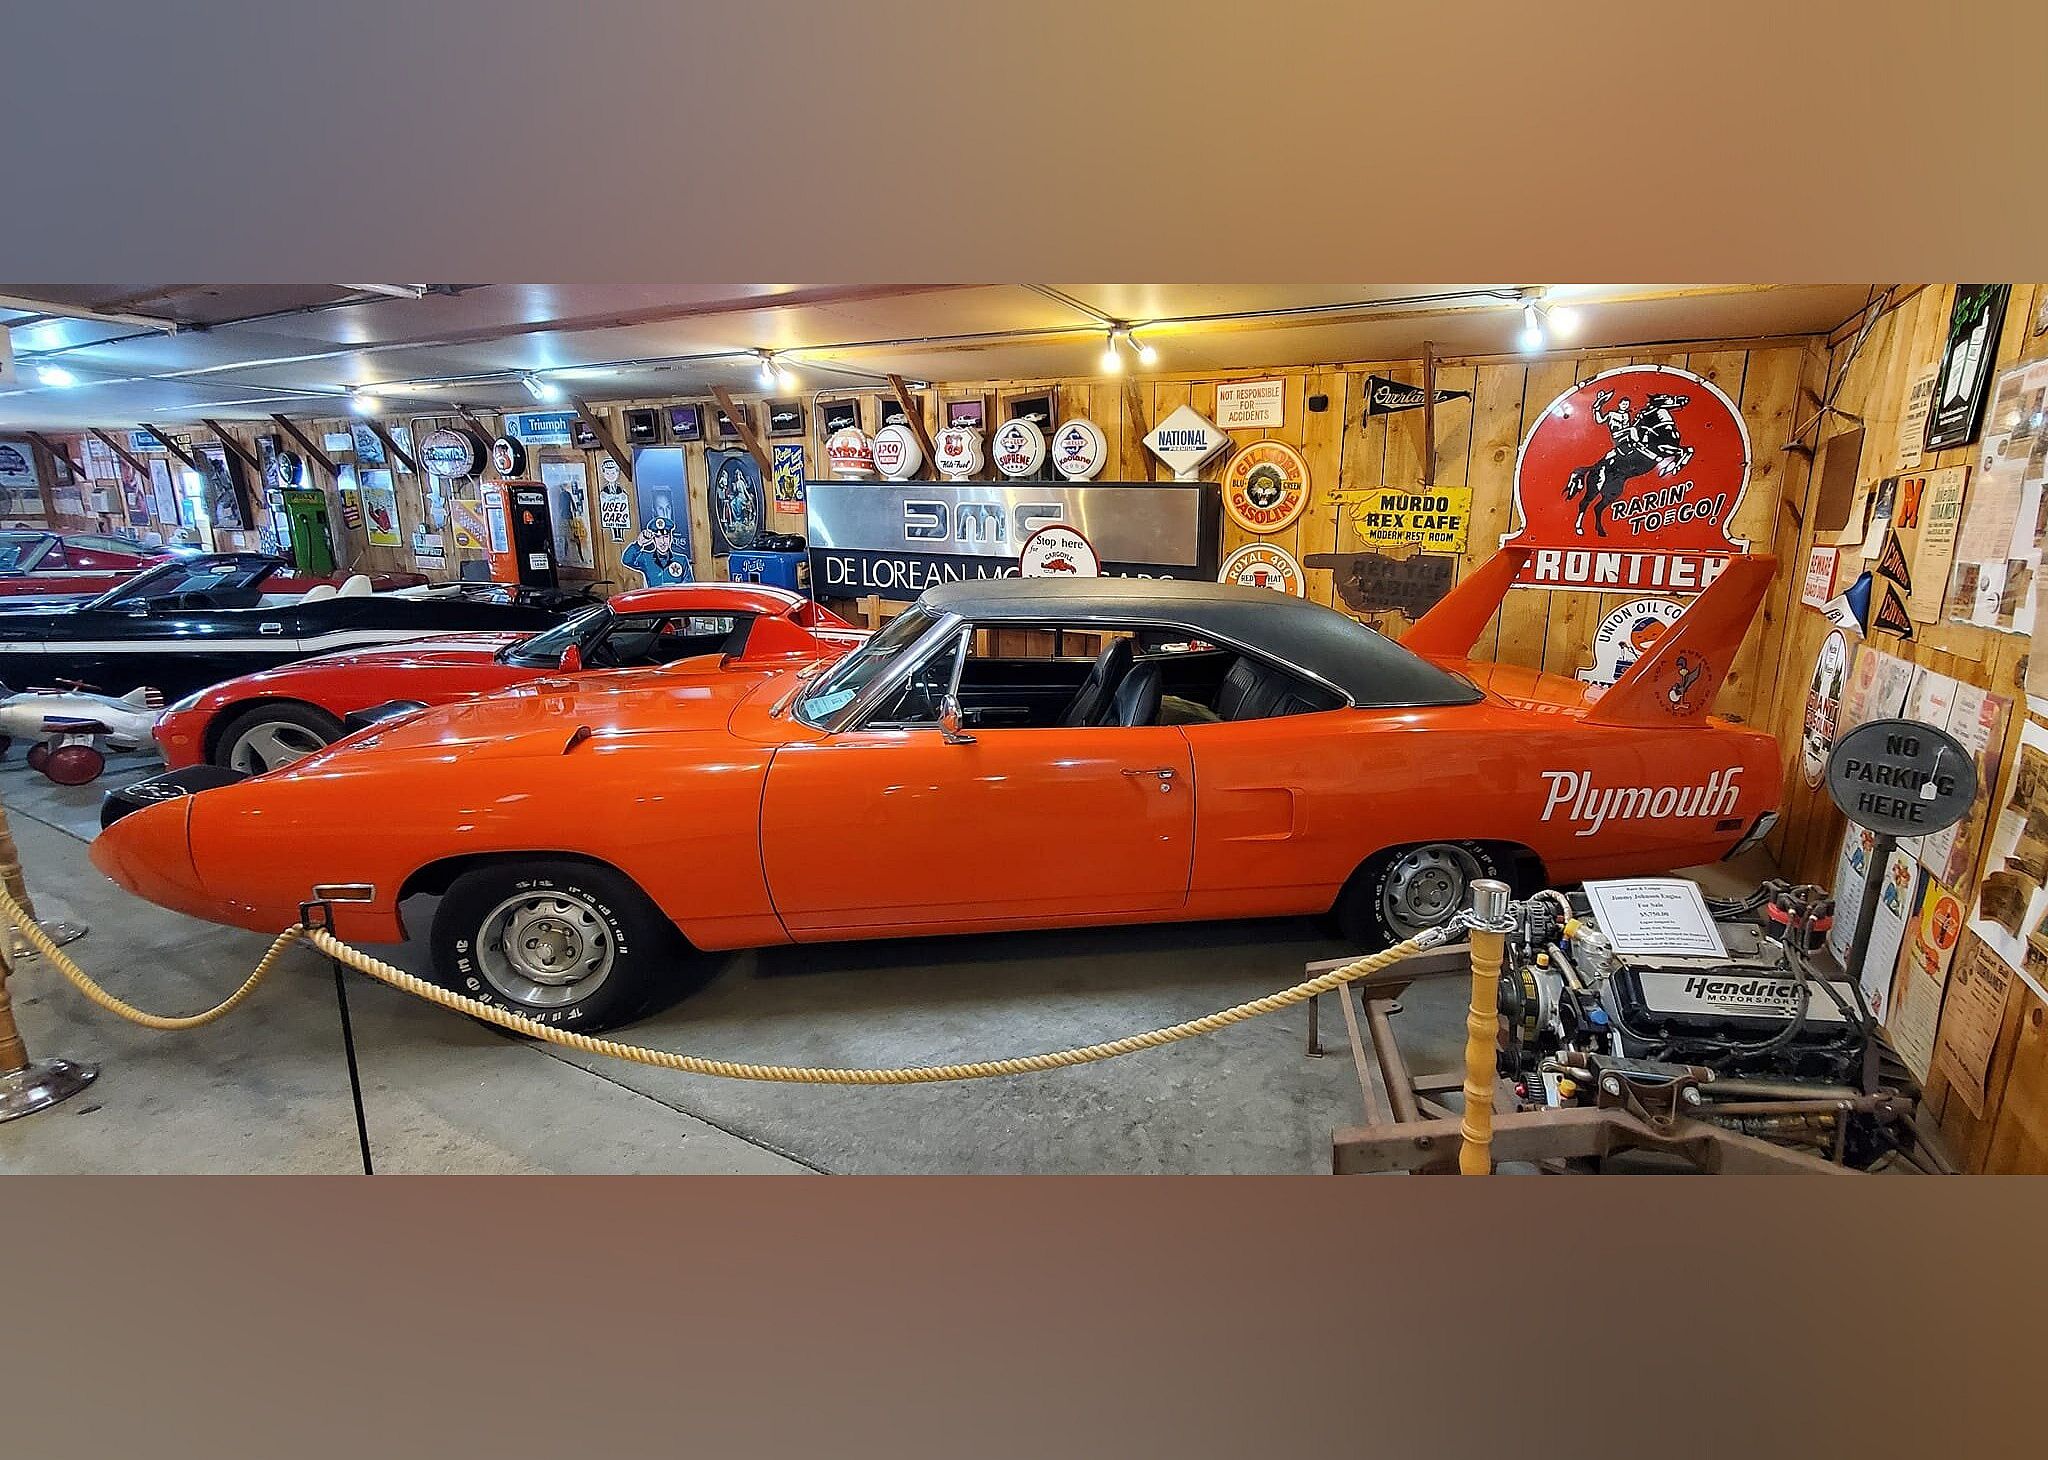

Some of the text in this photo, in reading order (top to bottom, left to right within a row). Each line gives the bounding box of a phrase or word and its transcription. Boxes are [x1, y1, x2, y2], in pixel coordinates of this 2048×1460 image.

[1220, 387, 1280, 401] NOT RESPONSIBLE
[1240, 401, 1255, 410] FOR
[1228, 410, 1269, 422] ACCIDENTS
[528, 417, 567, 432] Triumph
[1158, 430, 1208, 446] NATIONAL
[999, 454, 1031, 466] SUPREME
[602, 502, 627, 512] USED
[1232, 492, 1300, 525] GASOLINE
[1380, 495, 1449, 513] MURDO
[1611, 480, 1694, 521] RARIN'
[602, 512, 628, 524] CARS
[1366, 513, 1461, 530] REX CAFE
[1628, 493, 1727, 535] TO GO!
[1036, 535, 1084, 550] Stop here
[1369, 529, 1454, 542] MODERN REST ROOM
[1028, 545, 1039, 554] for
[826, 556, 858, 586] DE
[862, 557, 966, 591] LOREAN
[1229, 551, 1294, 580] ROYAL 400
[1240, 574, 1282, 583] RED HAT
[1599, 605, 1633, 643] UNION
[1636, 602, 1659, 614] OIL
[1886, 732, 1920, 758] NO
[1844, 759, 1955, 797] PARKING
[1540, 766, 1744, 837] Plymouth
[1858, 791, 1928, 823] HERE
[1707, 994, 1800, 1005] MOTORSPORT
